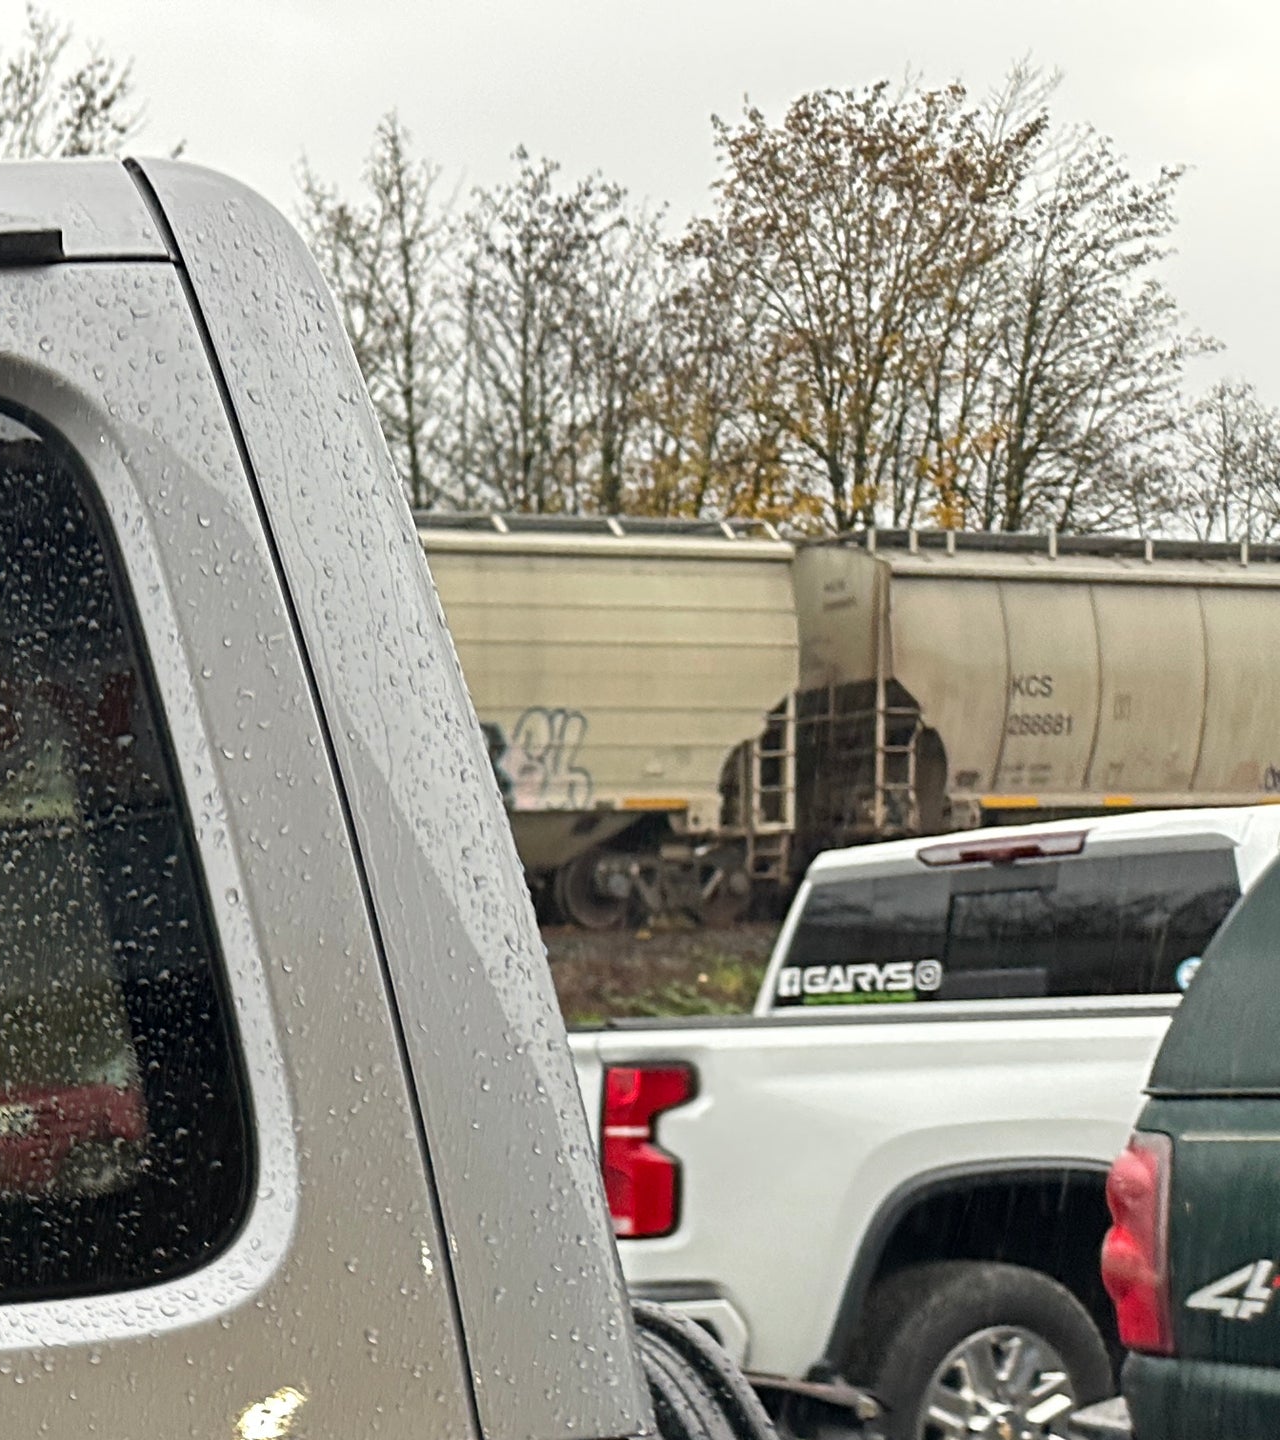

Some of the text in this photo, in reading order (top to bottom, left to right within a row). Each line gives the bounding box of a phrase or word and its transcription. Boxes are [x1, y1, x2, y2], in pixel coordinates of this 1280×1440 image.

[1010, 674, 1053, 698] KCS
[803, 961, 915, 994] GARYS
[1185, 1259, 1280, 1320] 4
